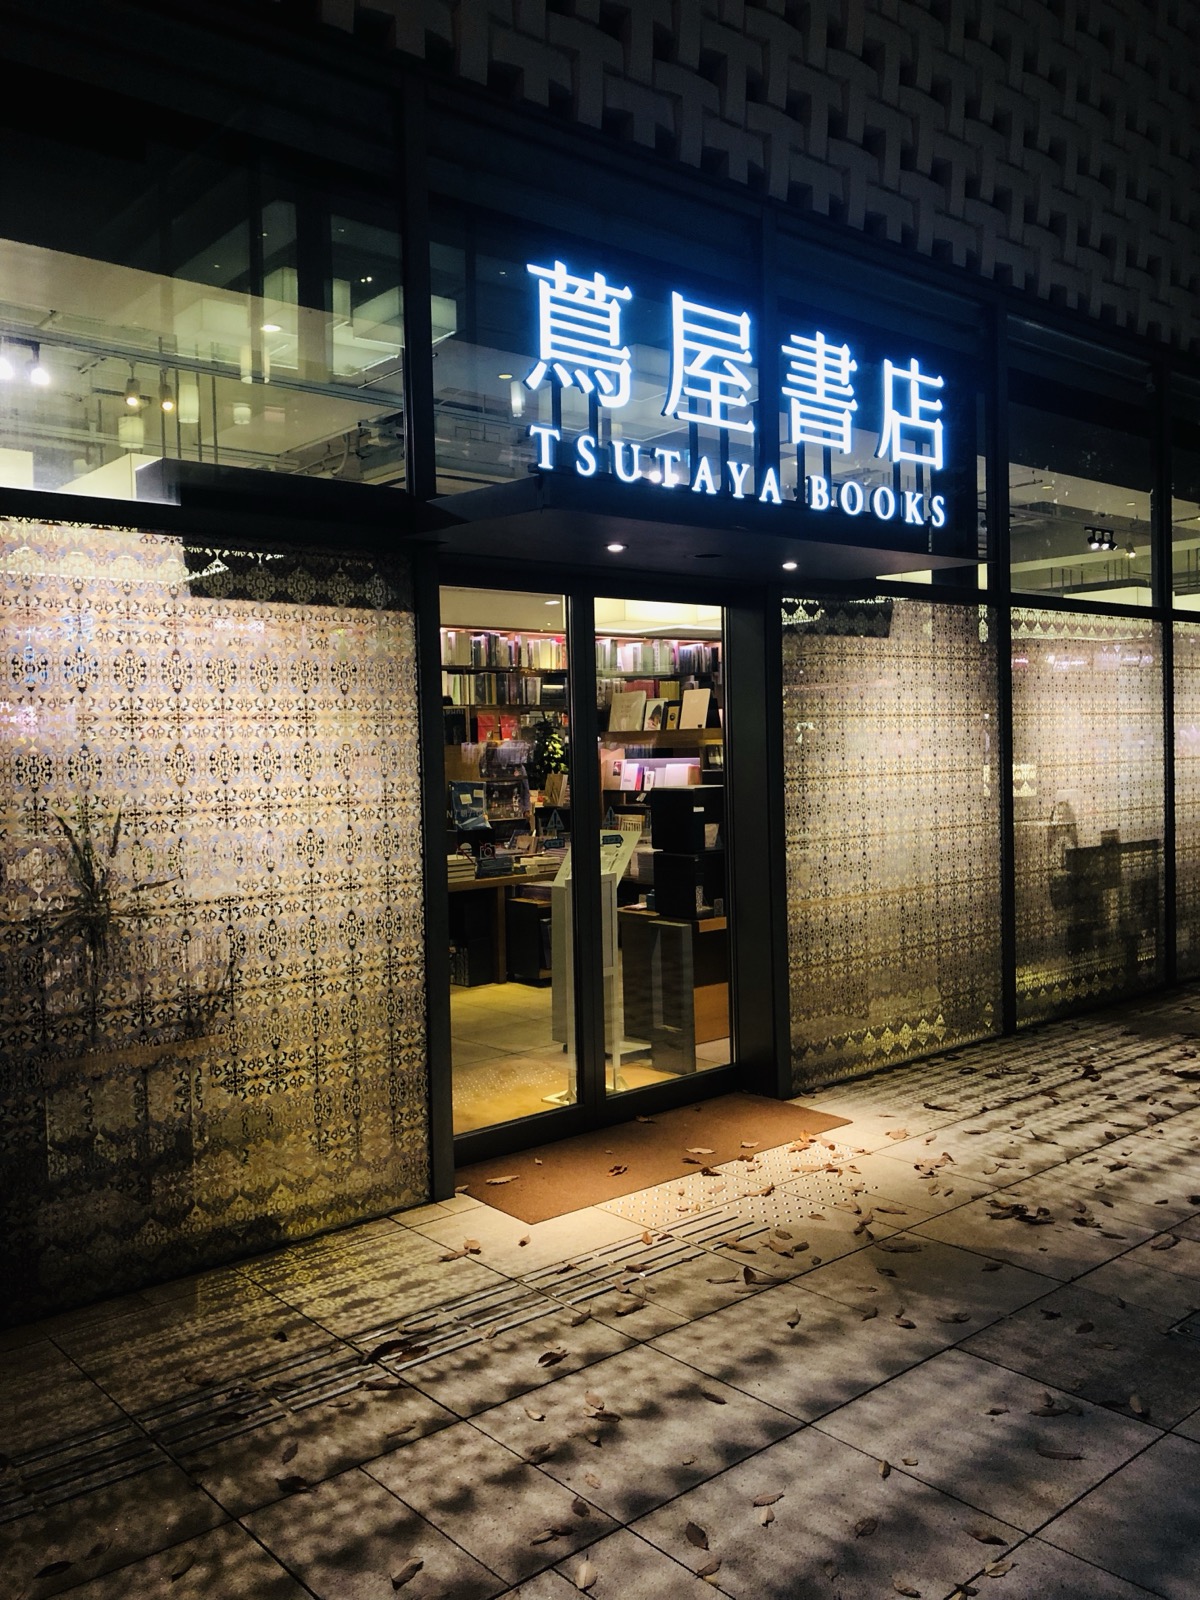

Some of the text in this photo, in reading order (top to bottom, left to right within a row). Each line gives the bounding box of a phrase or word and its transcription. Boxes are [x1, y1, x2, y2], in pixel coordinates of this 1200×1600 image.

[526, 261, 945, 471] 蔦屋書店
[529, 425, 947, 528] TSUTAYA BOOKS
